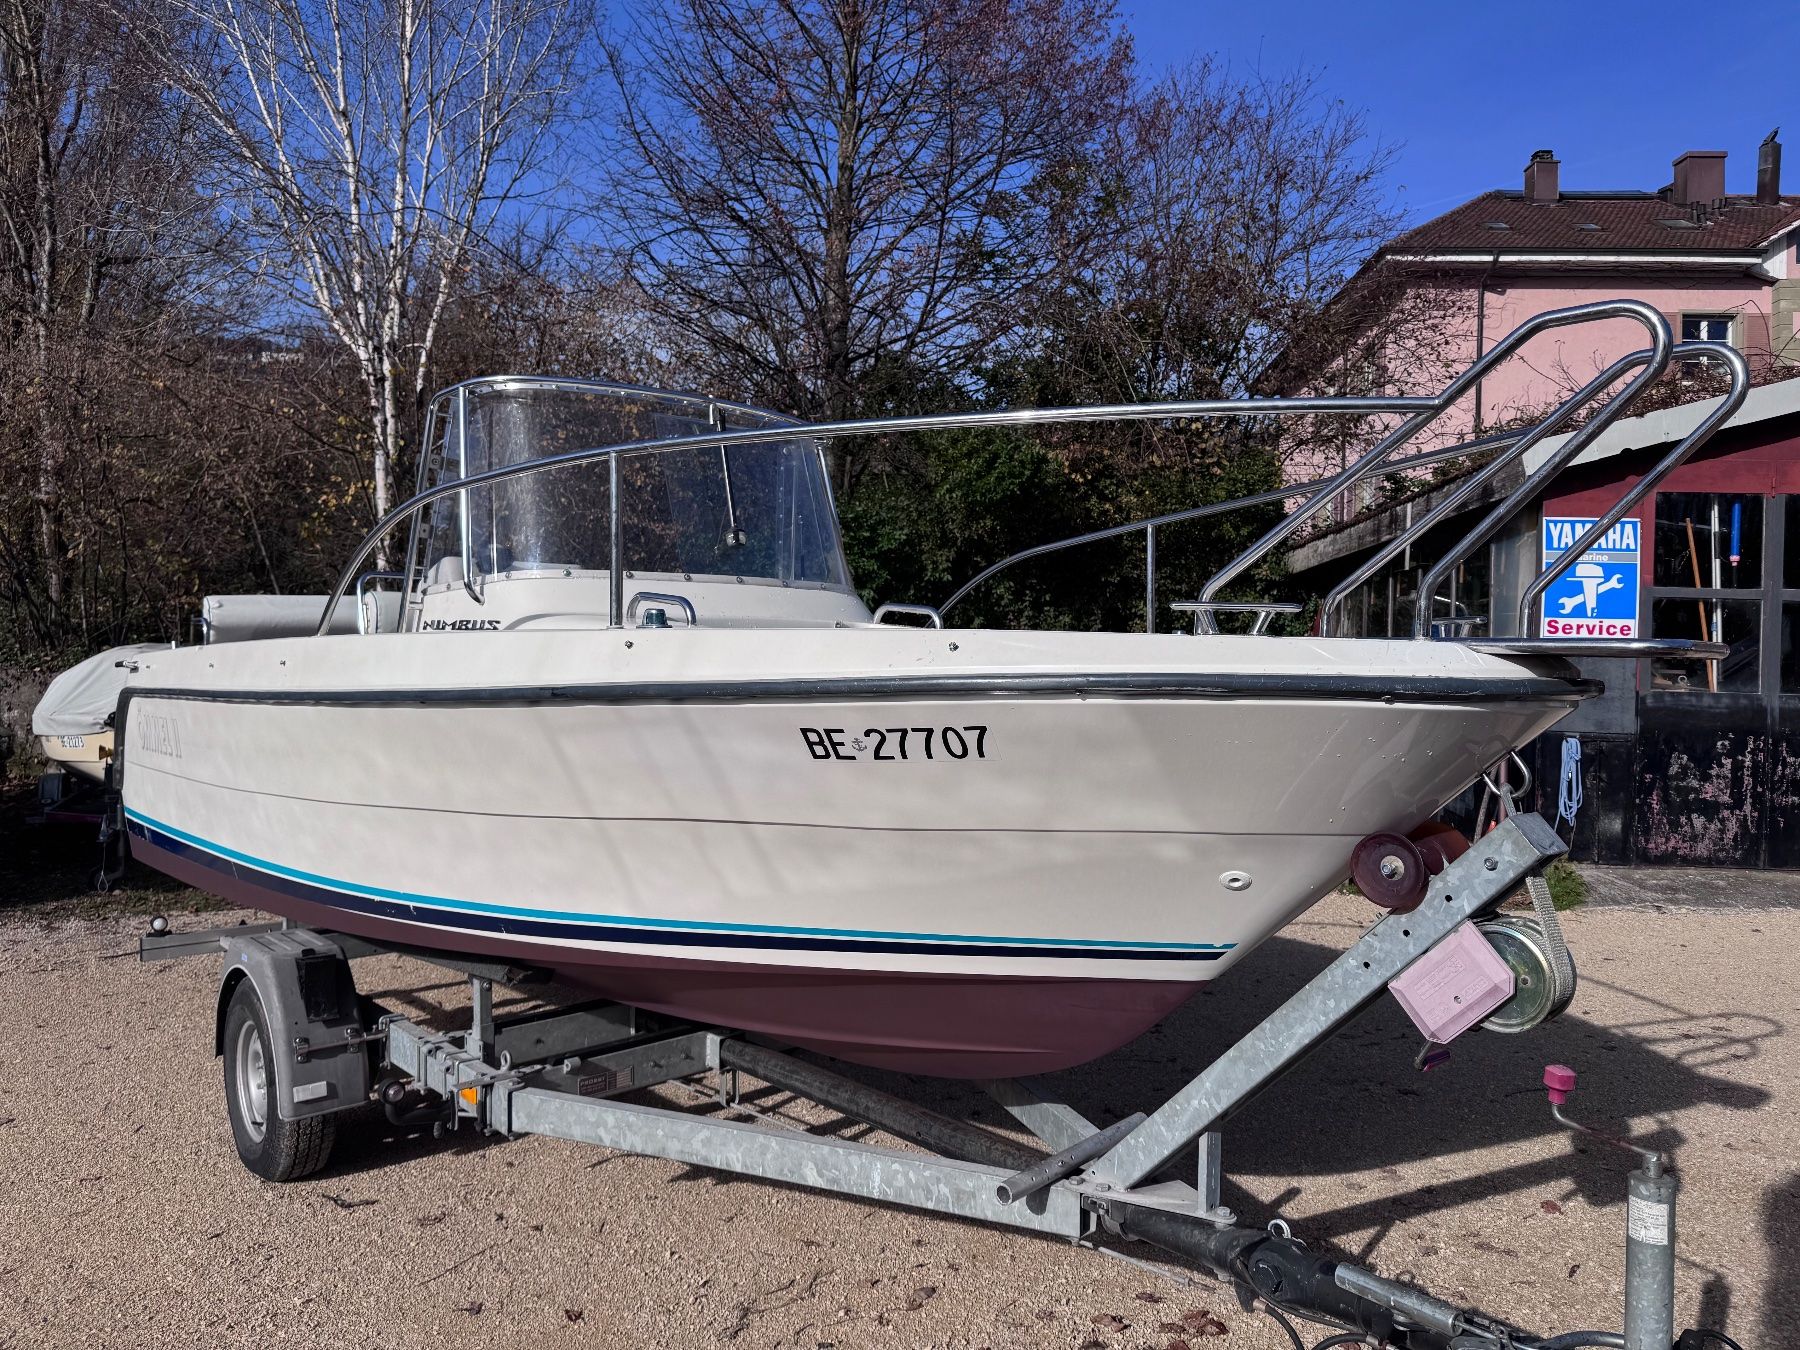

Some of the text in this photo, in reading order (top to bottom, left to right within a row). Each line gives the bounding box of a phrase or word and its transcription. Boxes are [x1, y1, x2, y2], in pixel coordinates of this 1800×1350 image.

[1579, 553, 1609, 562] arine
[422, 619, 501, 631] NIMBUS
[1546, 619, 1632, 637] Service
[799, 725, 988, 760] BE 27707
